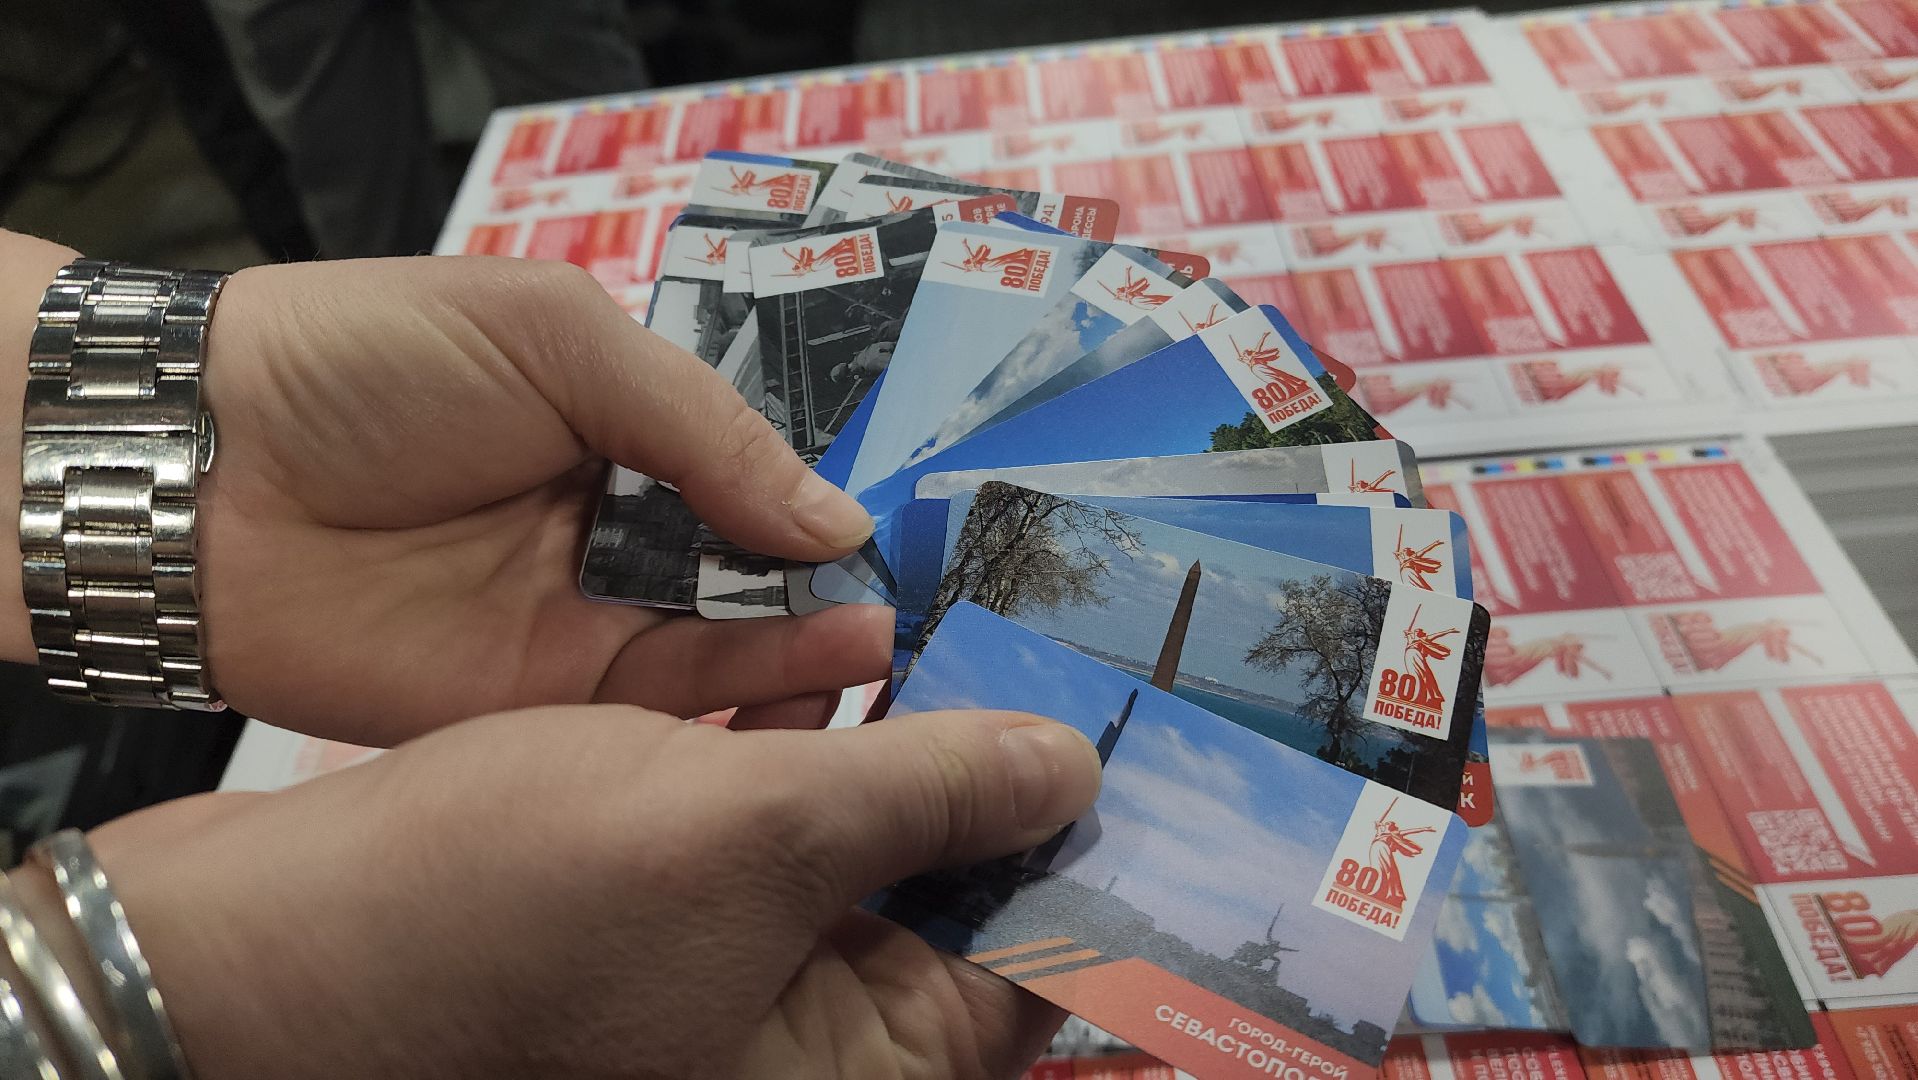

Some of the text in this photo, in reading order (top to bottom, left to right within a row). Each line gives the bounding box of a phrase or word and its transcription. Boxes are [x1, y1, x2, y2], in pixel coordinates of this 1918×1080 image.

[767, 188, 791, 208] 80
[834, 255, 859, 278] 80
[859, 234, 876, 274] ПОБЕДА!
[1000, 265, 1027, 288] 80
[1028, 250, 1051, 292] ПОБЕДА!
[1252, 382, 1286, 410] 80
[1267, 393, 1322, 424] ПОБЕДА!
[1379, 668, 1417, 701] 80
[1373, 699, 1442, 730] ПОБЕДА!
[1336, 859, 1379, 895] 80
[1325, 888, 1400, 929] ПОБЕДА!
[1820, 891, 1883, 936] 80
[1228, 1018, 1349, 1080] ГОРОД-ГЕРОЙ
